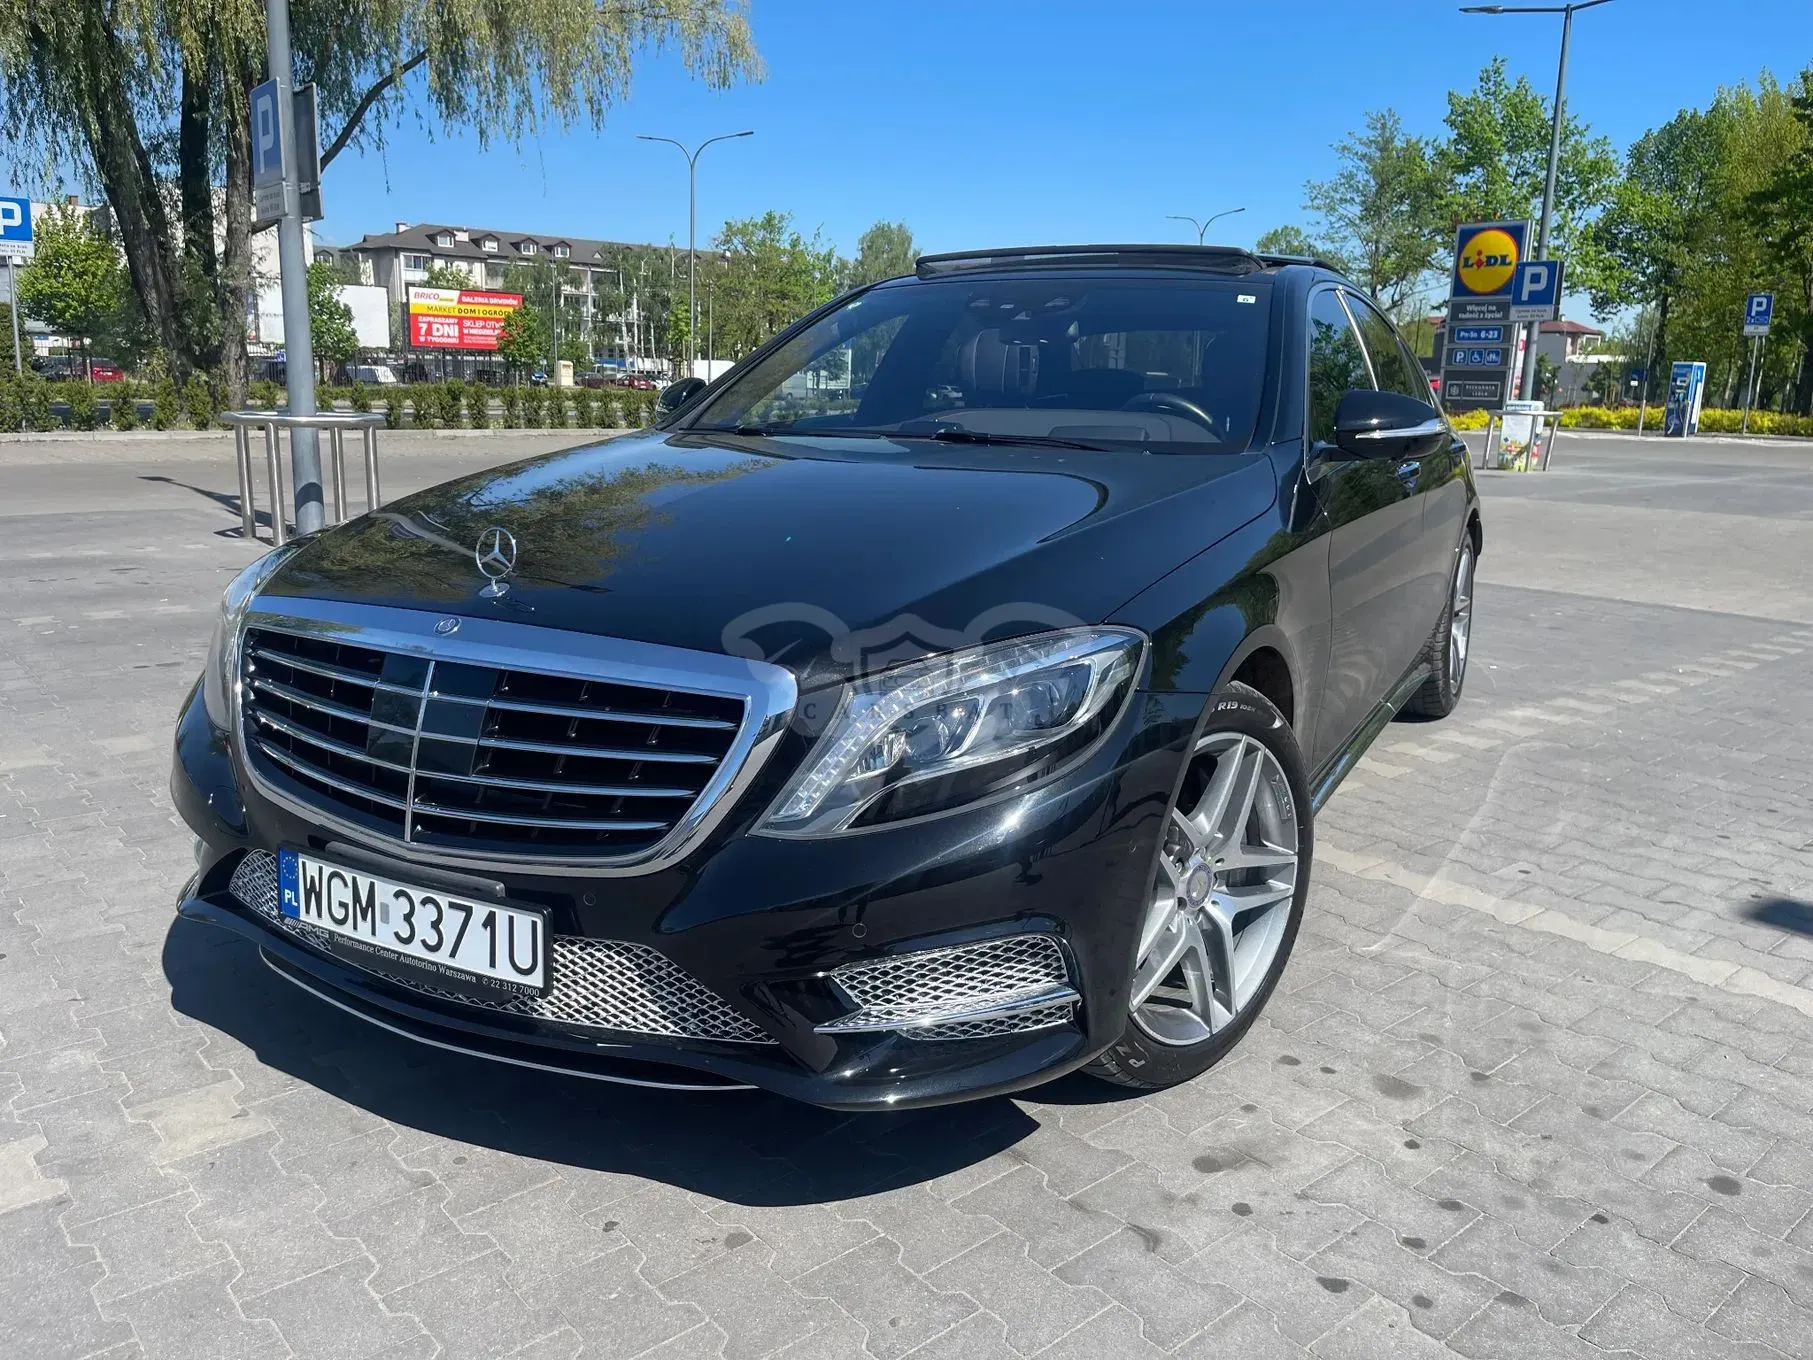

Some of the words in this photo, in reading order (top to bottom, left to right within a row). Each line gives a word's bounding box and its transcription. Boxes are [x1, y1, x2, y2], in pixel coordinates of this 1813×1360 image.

[257, 94, 274, 174] P
[0, 201, 22, 236] P
[1521, 265, 1548, 301] P
[427, 305, 456, 314] MARKET
[457, 307, 476, 315] DOM
[1751, 297, 1767, 316] P
[418, 316, 458, 324] ZAPRASZAMY
[463, 320, 485, 328] SKLEP
[418, 323, 428, 335] 7
[432, 324, 459, 337] DNI
[1480, 330, 1498, 338] 6-23
[426, 336, 459, 344] TYGODNIU
[1217, 700, 1239, 711] R19
[284, 888, 298, 907] PL
[301, 860, 377, 938] WGM
[392, 888, 539, 976] 3371U
[334, 932, 375, 954] Performance
[375, 946, 399, 961] Center
[400, 954, 437, 972] Autotorino
[438, 963, 477, 984] Warszawa
[490, 979, 501, 989] 22
[502, 981, 518, 993] 312
[519, 985, 540, 997] 7000
